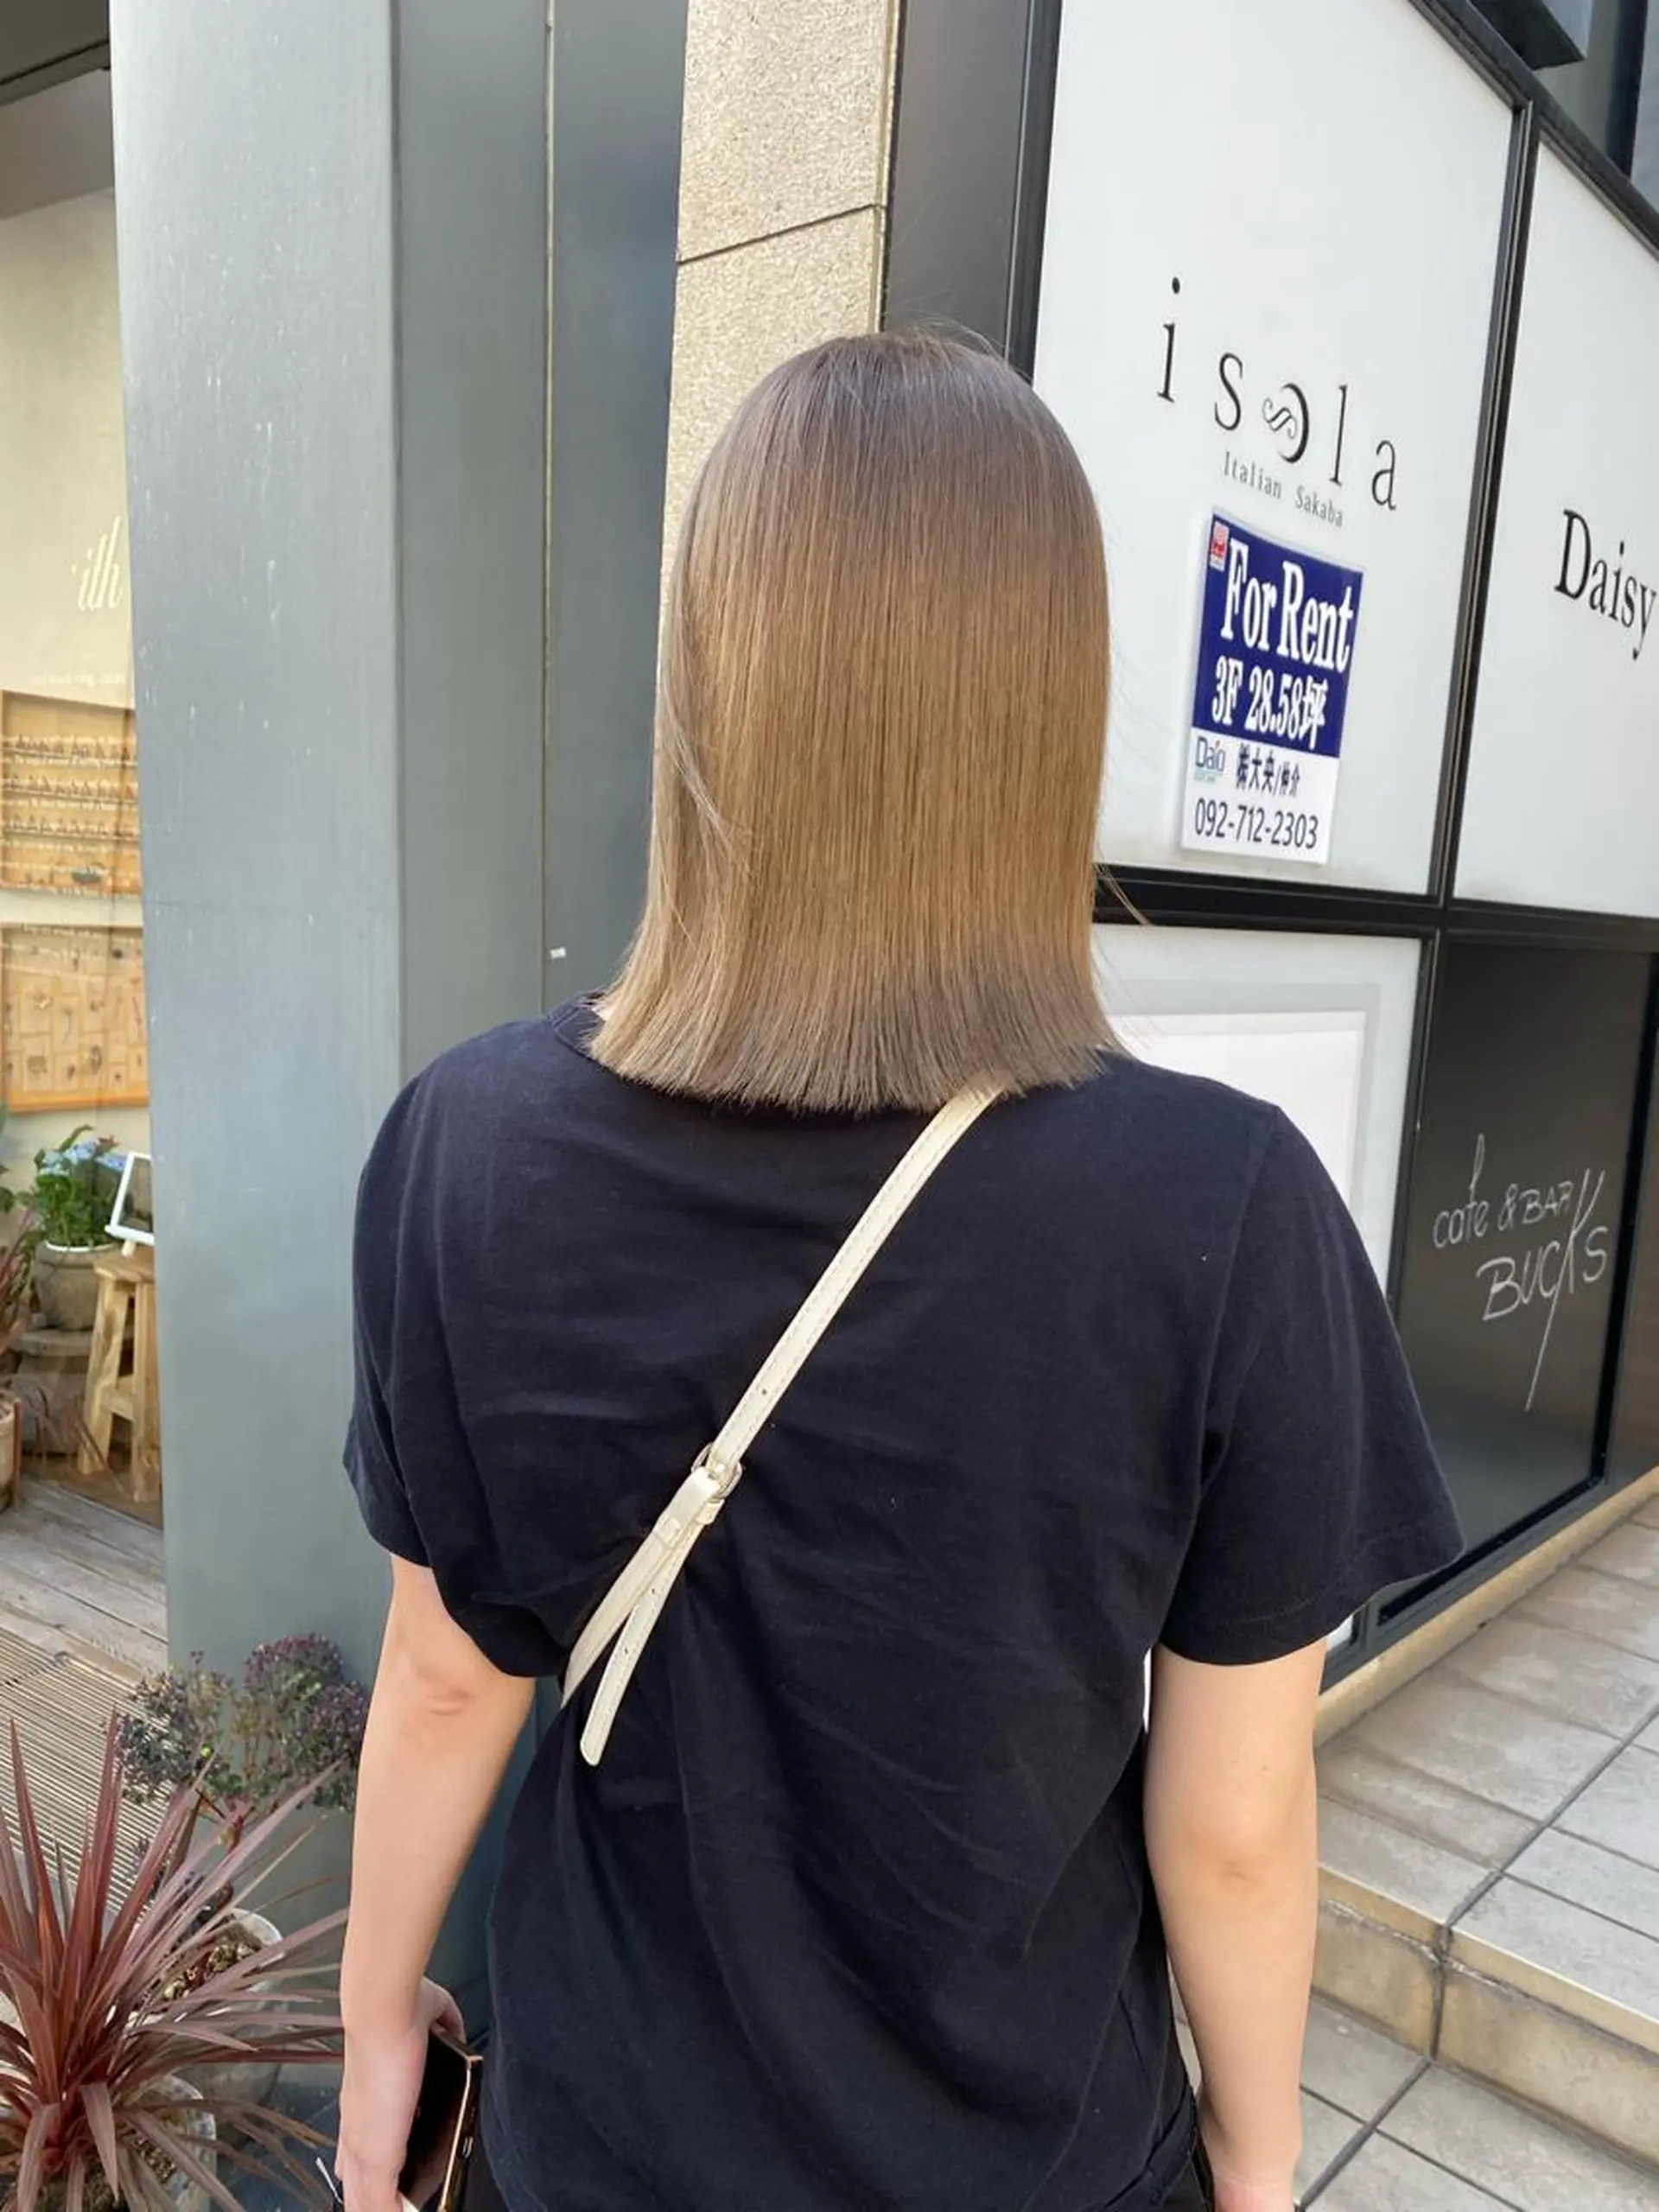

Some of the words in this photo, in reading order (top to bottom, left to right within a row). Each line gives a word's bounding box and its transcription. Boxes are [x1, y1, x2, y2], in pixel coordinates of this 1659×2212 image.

[1223, 449, 1282, 500] Italian
[1294, 484, 1344, 528] Sakaba
[1554, 507, 1658, 662] Daisy
[1211, 655, 1244, 727] 3F
[1194, 797, 1320, 850] 092-712-2303
